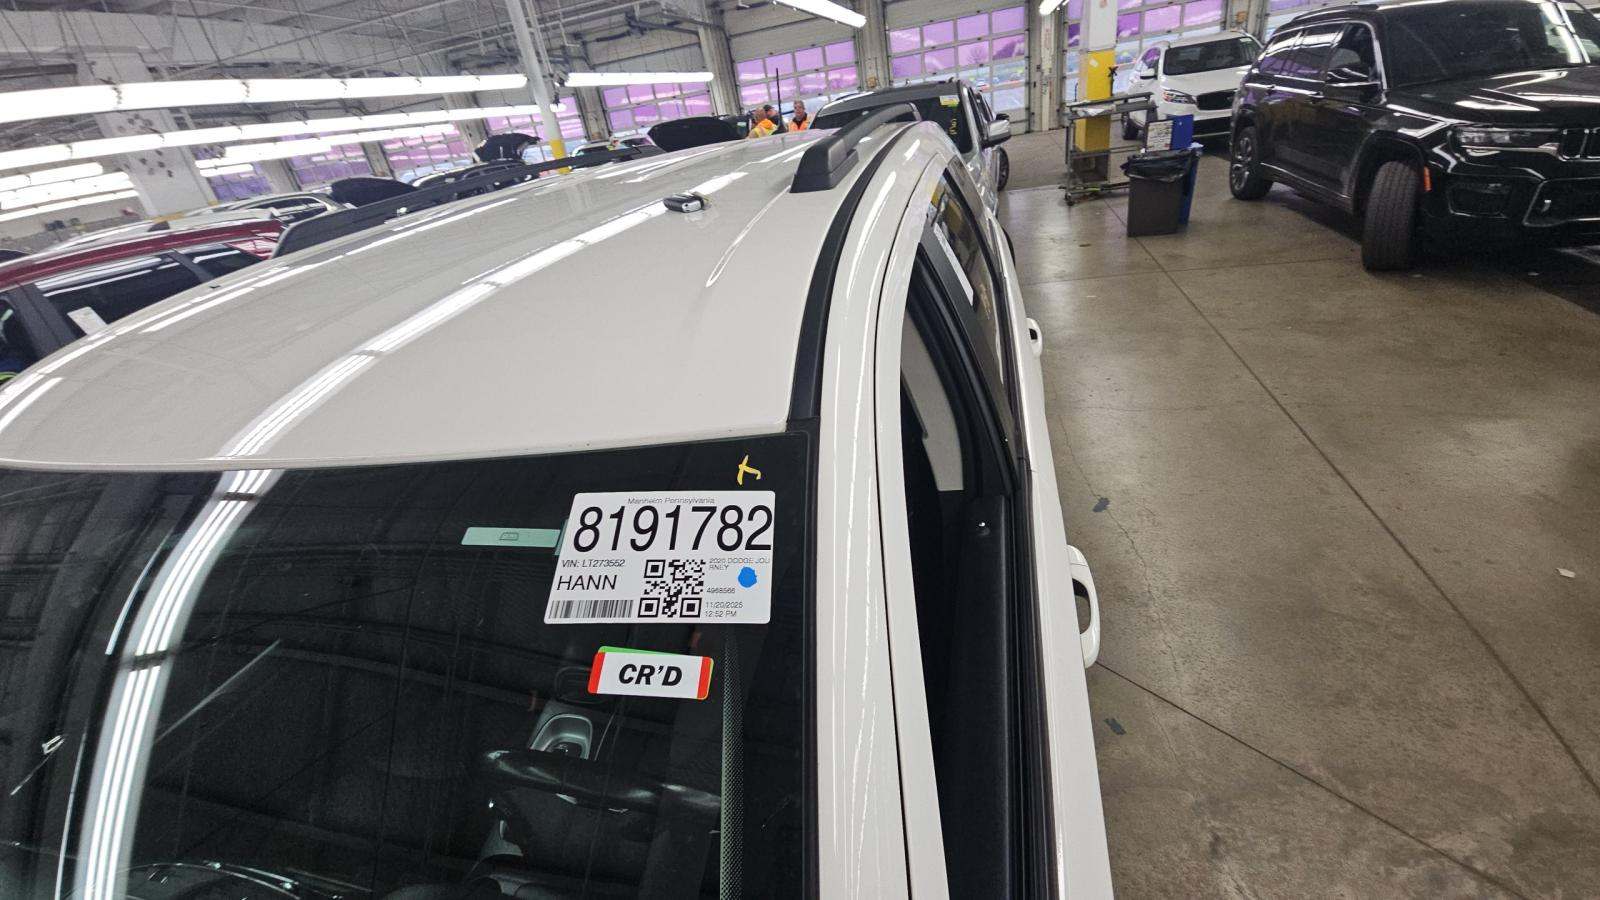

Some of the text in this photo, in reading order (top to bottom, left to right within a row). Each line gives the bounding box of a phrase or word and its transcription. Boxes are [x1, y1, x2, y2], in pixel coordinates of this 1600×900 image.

[573, 504, 773, 553] 8191782
[562, 558, 626, 568] VIN: LT273552
[557, 574, 618, 591] HANN
